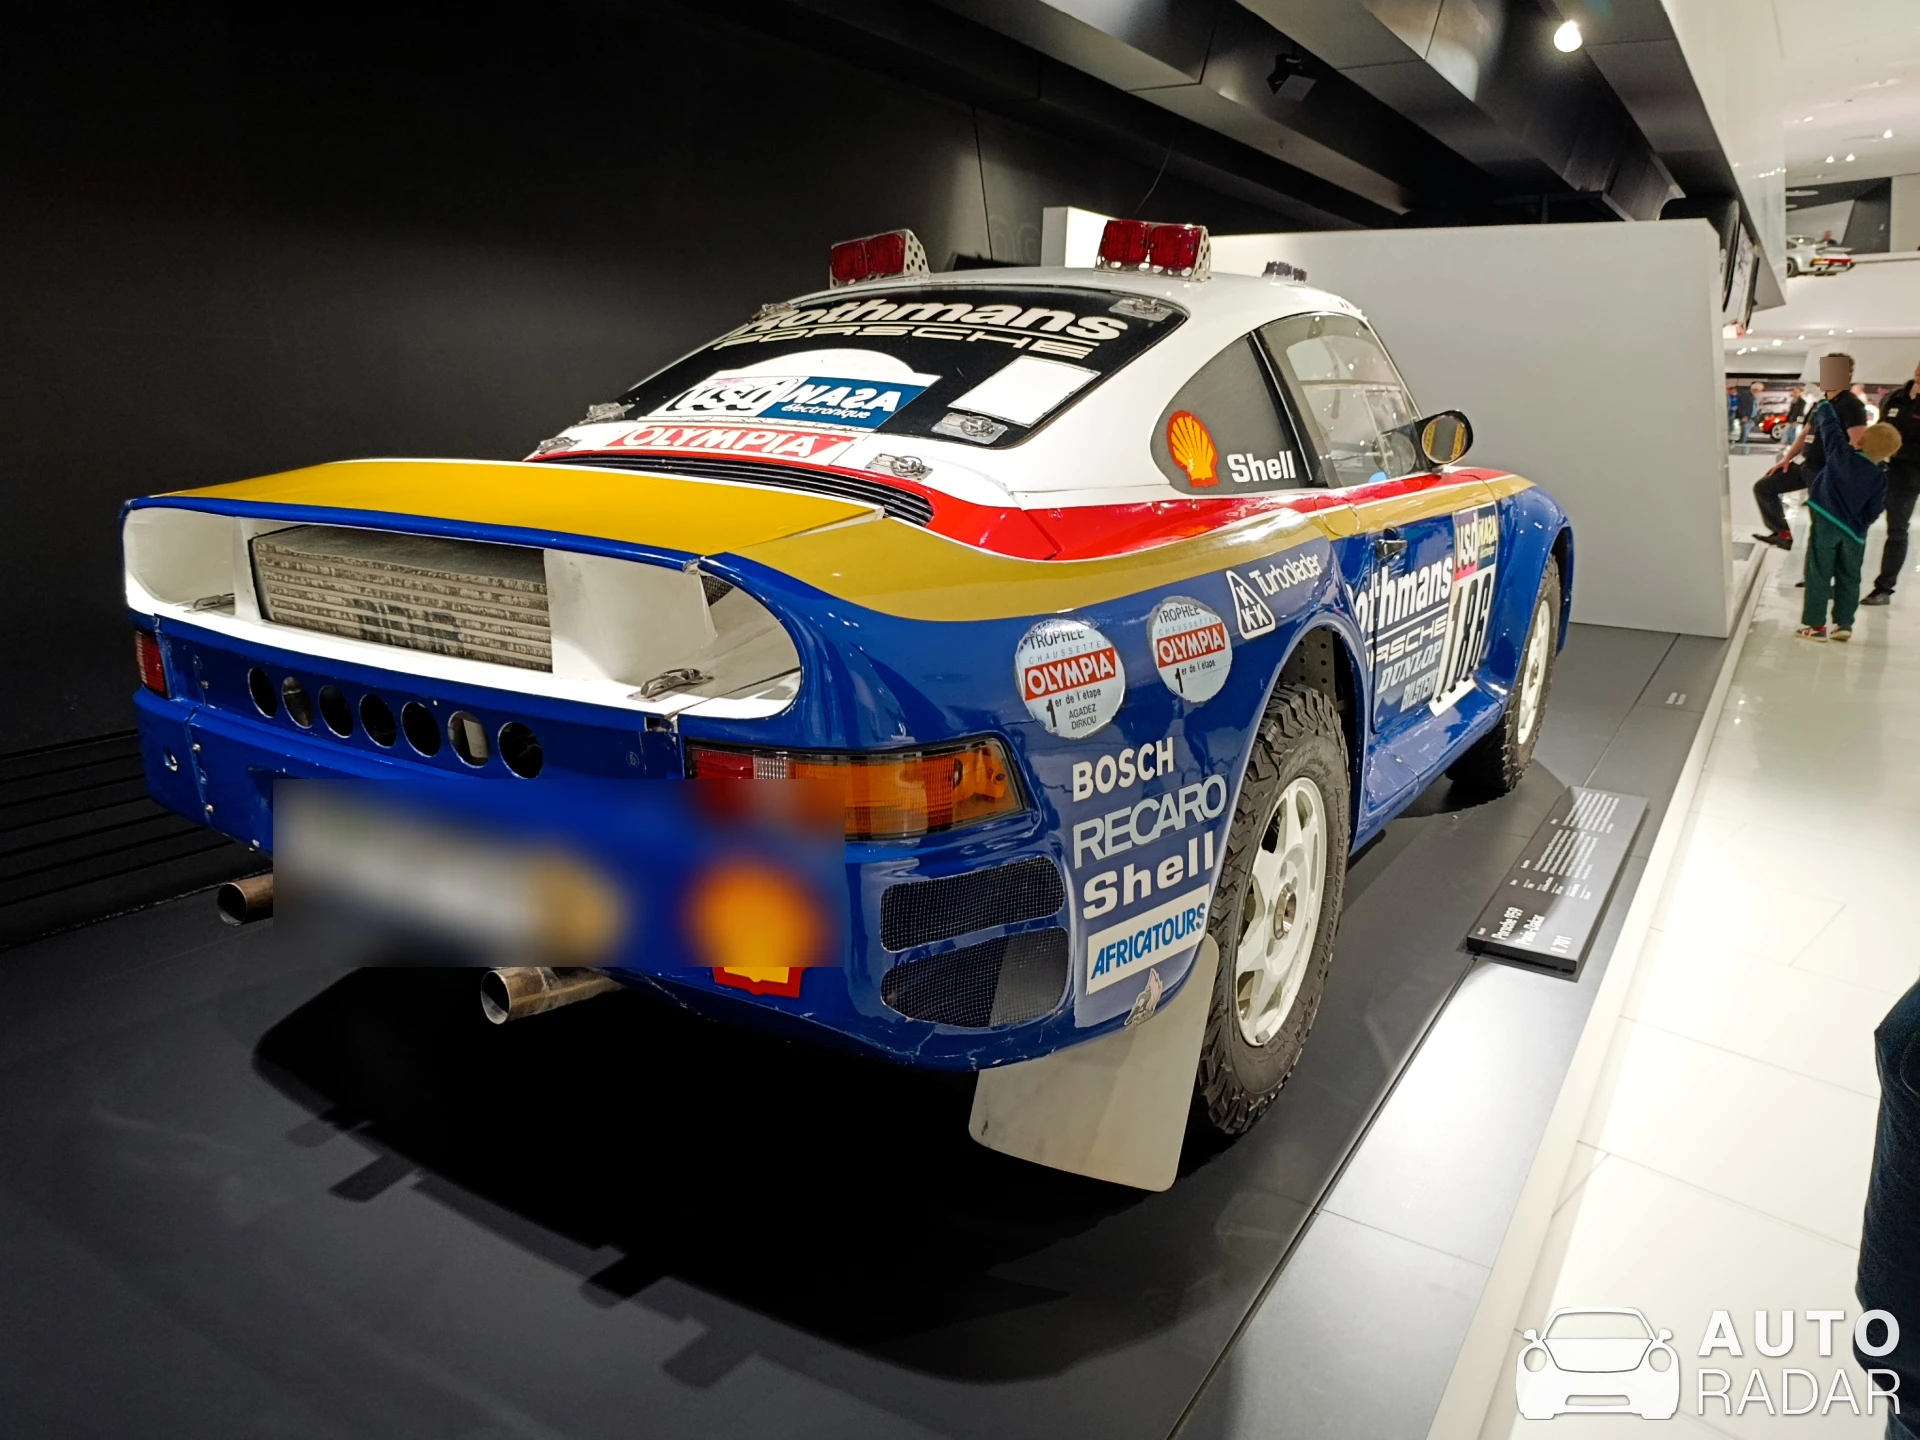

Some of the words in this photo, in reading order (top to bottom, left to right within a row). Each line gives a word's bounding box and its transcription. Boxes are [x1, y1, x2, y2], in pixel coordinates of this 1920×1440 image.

[713, 326, 1094, 360] PORSCHE
[623, 426, 818, 457] OLYMPIA
[1227, 451, 1296, 482] Shell
[1248, 553, 1322, 597] Turbolader
[1346, 557, 1453, 634] othmans
[1159, 616, 1218, 636] CHAUSSETTES
[1029, 640, 1109, 664] CHAUSSETTES
[1159, 627, 1224, 663] OLYMPIA
[1027, 652, 1114, 695] OLYMPIA
[1189, 663, 1196, 673] de
[1377, 638, 1443, 695] DUNLOP
[1066, 693, 1075, 705] de
[1068, 703, 1097, 720] AGADEZ
[1071, 715, 1097, 730] DIRKOU
[1072, 737, 1174, 802] BOSCH
[1073, 775, 1227, 869] RECARO
[1083, 830, 1214, 920] Shell
[1490, 918, 1518, 940] Porsche
[1503, 906, 1524, 920] 959
[1091, 902, 1206, 980] AFRICATOURS
